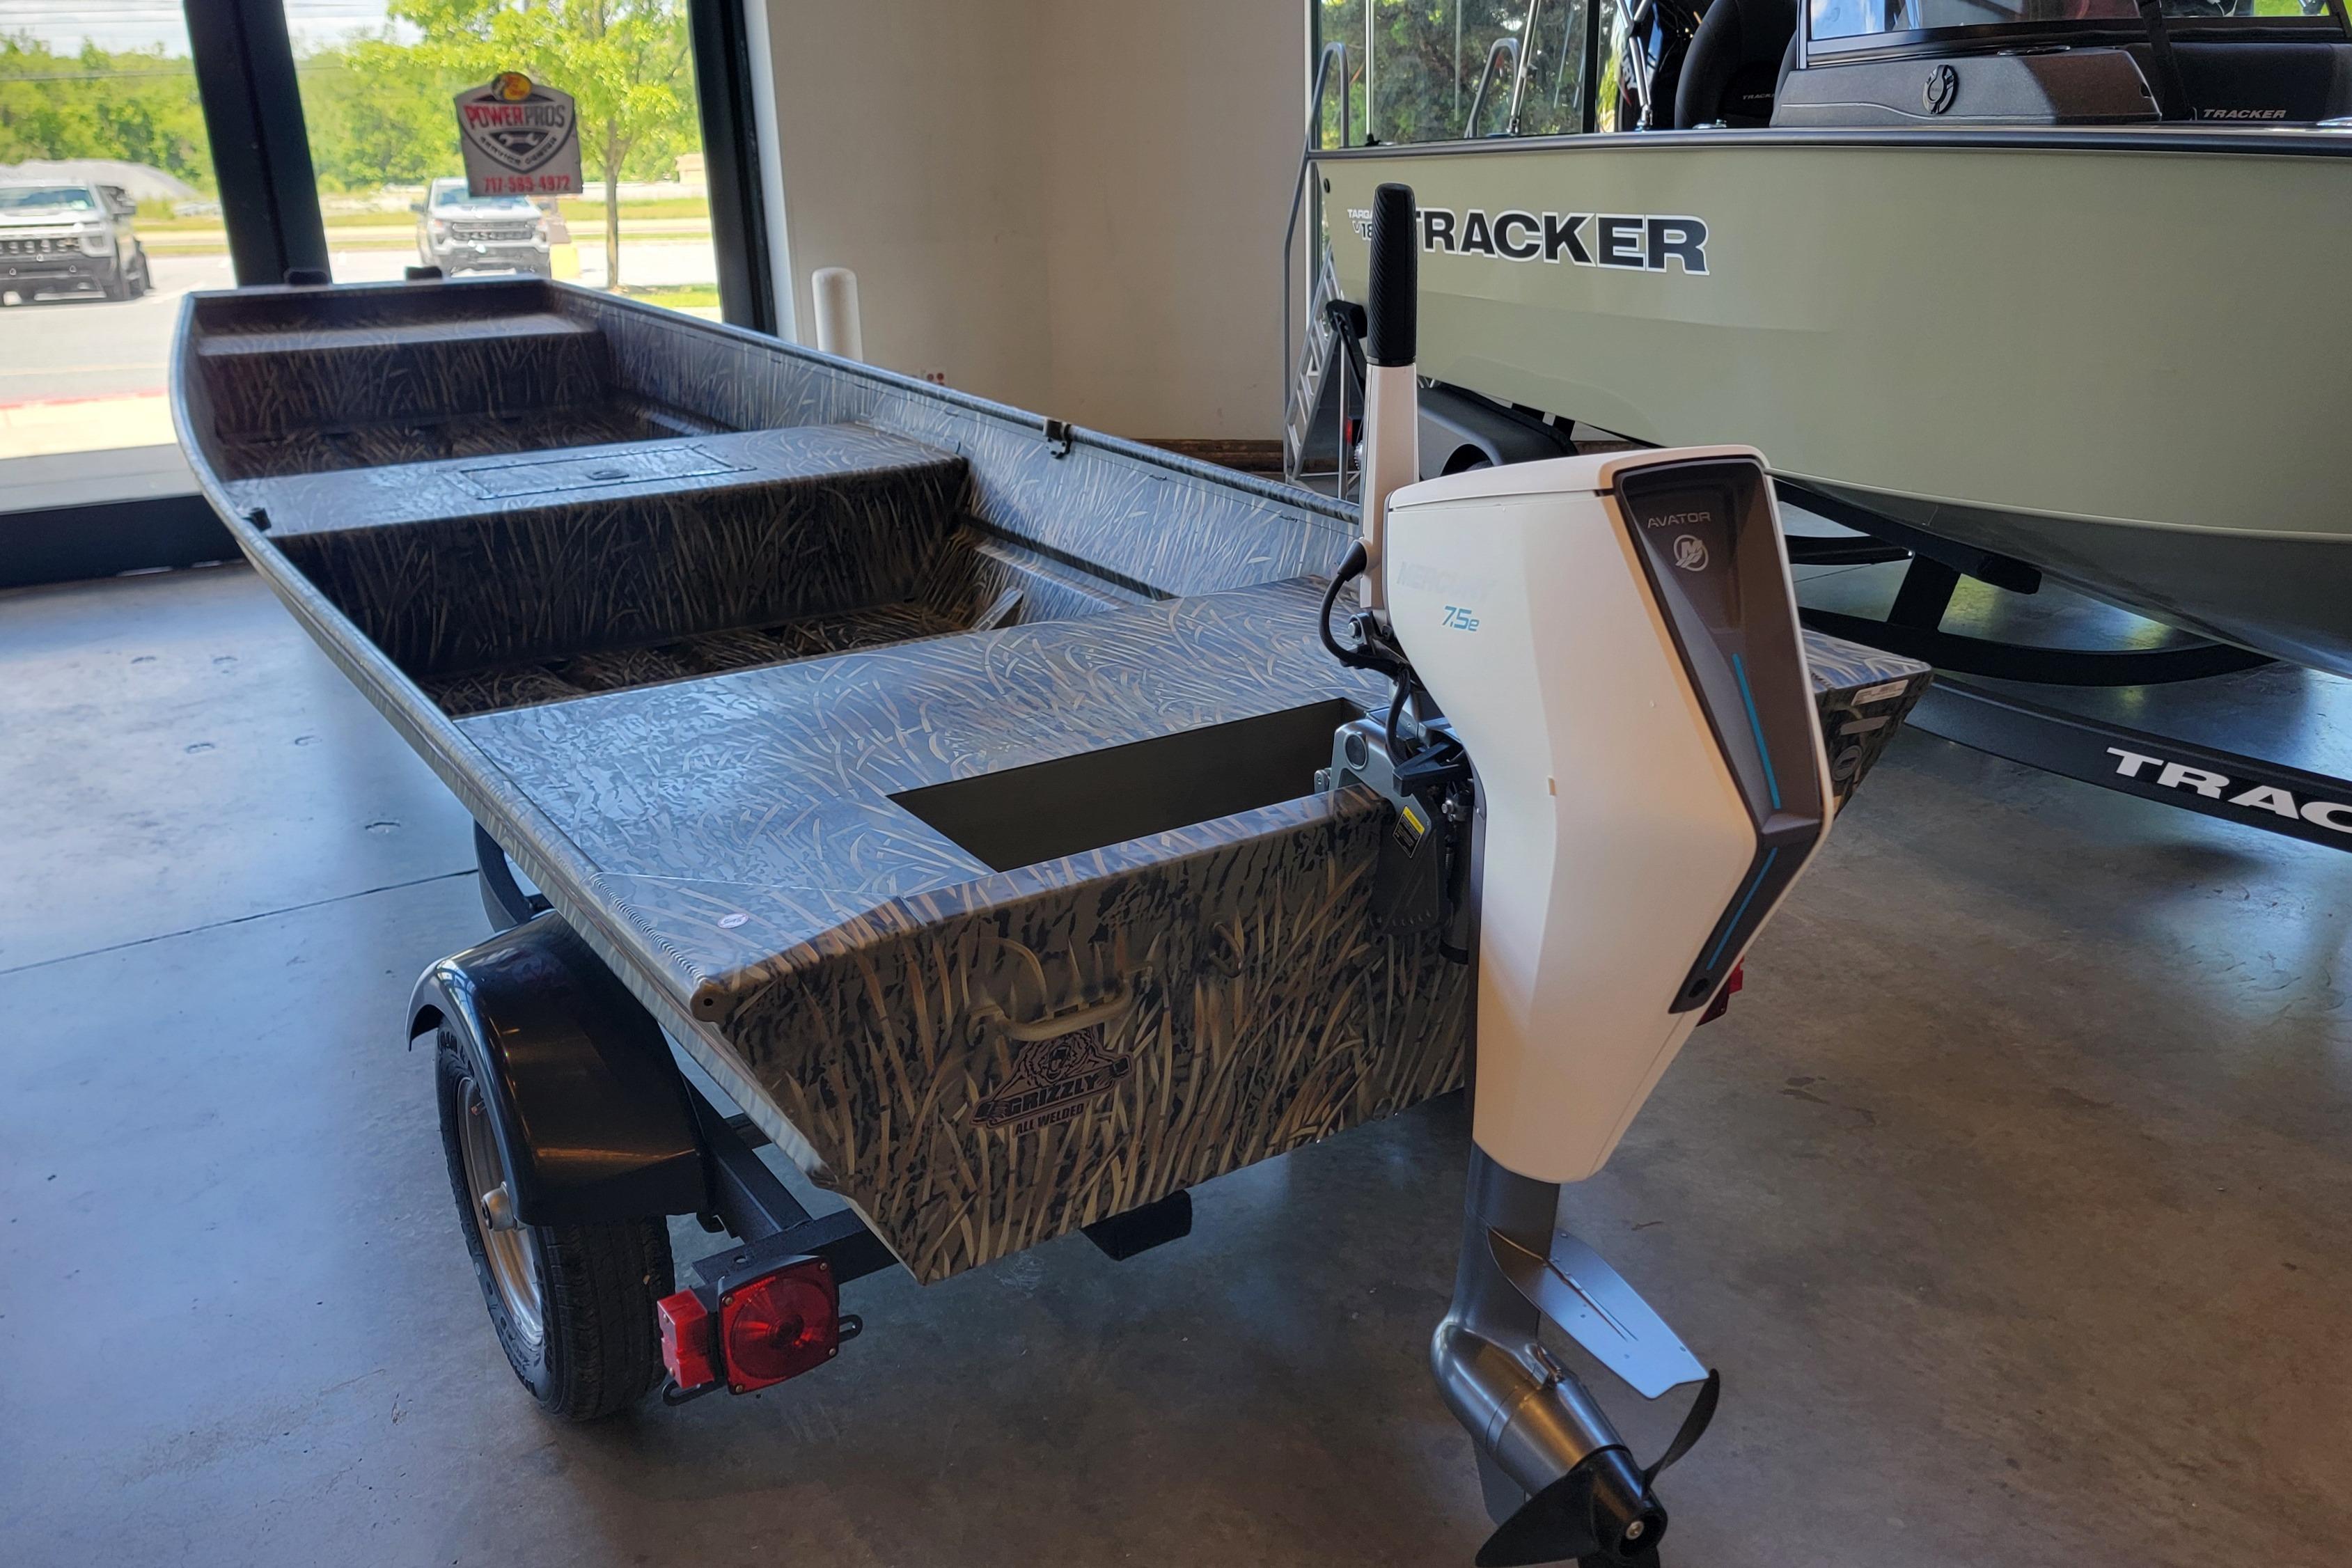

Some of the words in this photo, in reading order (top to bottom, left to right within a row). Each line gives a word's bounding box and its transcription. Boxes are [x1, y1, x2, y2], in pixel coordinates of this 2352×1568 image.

[2203, 109, 2287, 118] TRACKER
[1415, 207, 1710, 276] RACKER
[1647, 512, 1711, 528] AVATOR
[1442, 605, 1480, 632] 7.5e
[1009, 1073, 1101, 1116] GRIZZLY
[1015, 1119, 1035, 1136] ALL
[1037, 1102, 1085, 1127] WELDED
